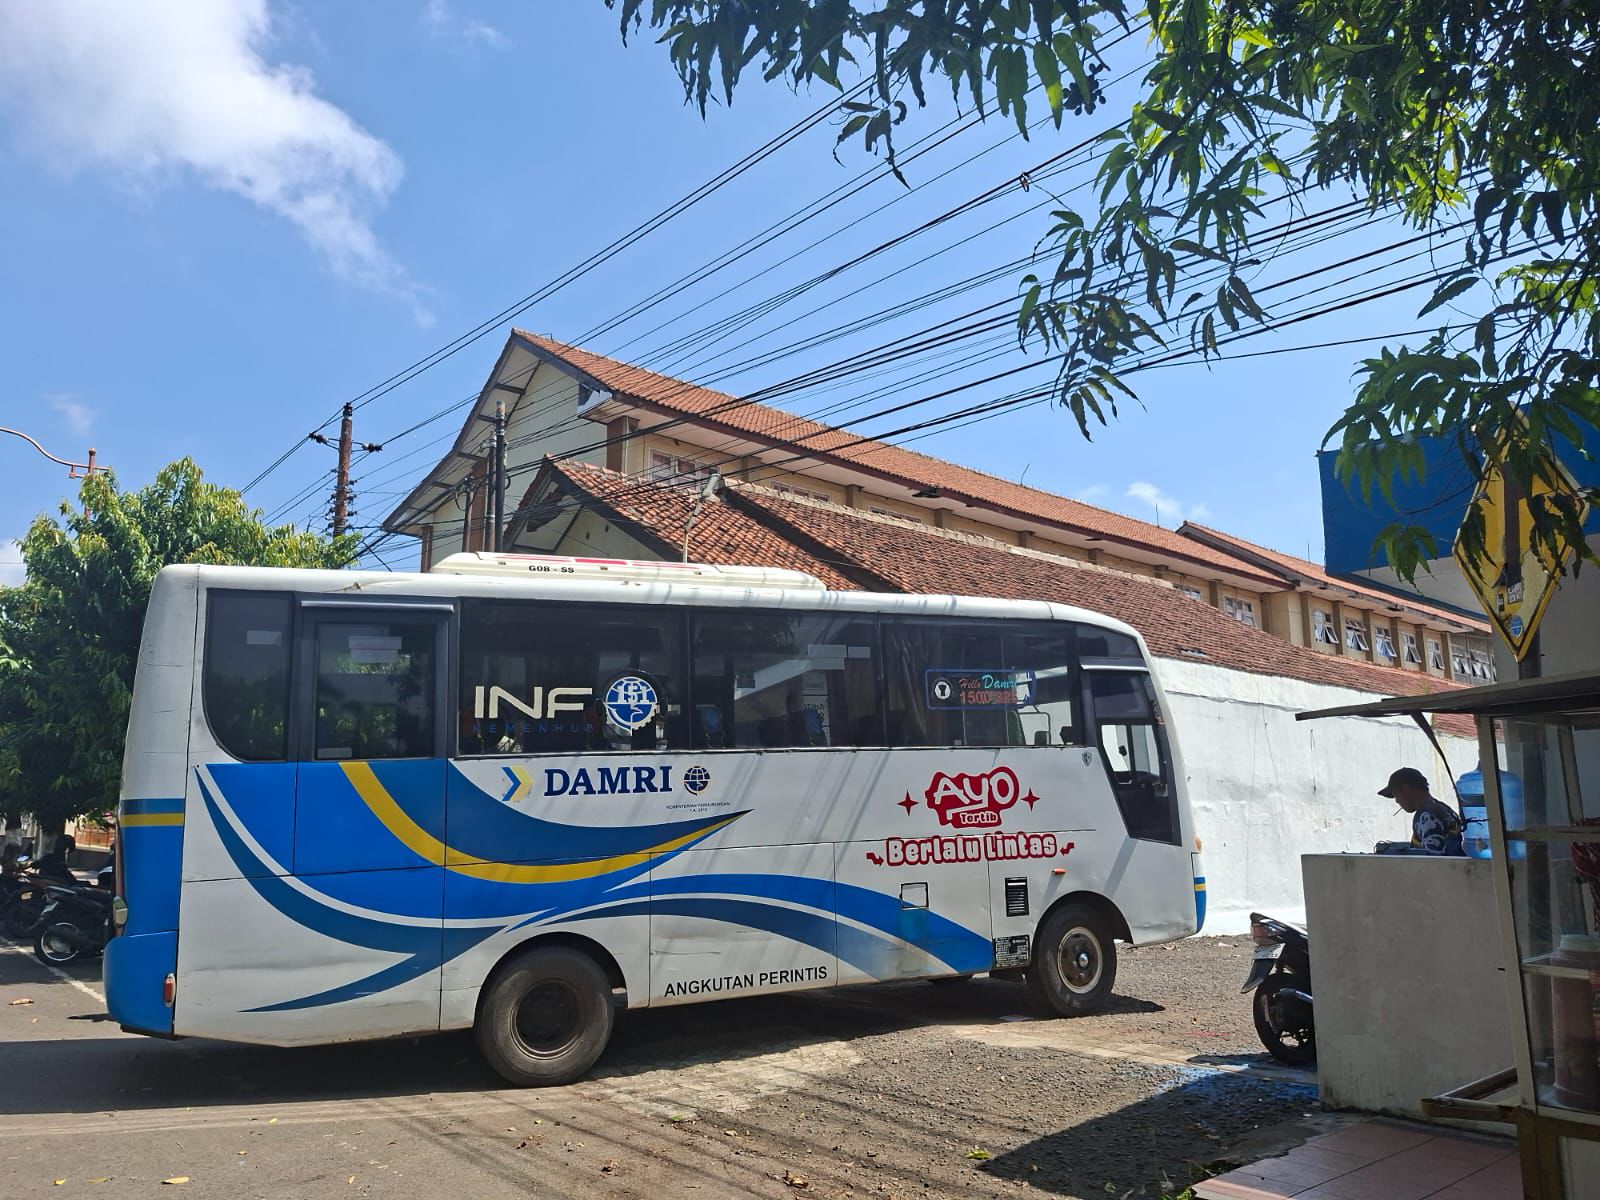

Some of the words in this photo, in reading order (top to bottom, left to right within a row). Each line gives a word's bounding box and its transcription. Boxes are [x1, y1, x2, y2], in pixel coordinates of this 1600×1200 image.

[544, 766, 672, 796] DAMRI
[960, 811, 998, 824] Tertib
[887, 837, 980, 865] Berlalu
[985, 832, 1057, 861] Lintas
[664, 974, 754, 997] ANGKUTAN
[759, 966, 827, 985] PERINTIS
